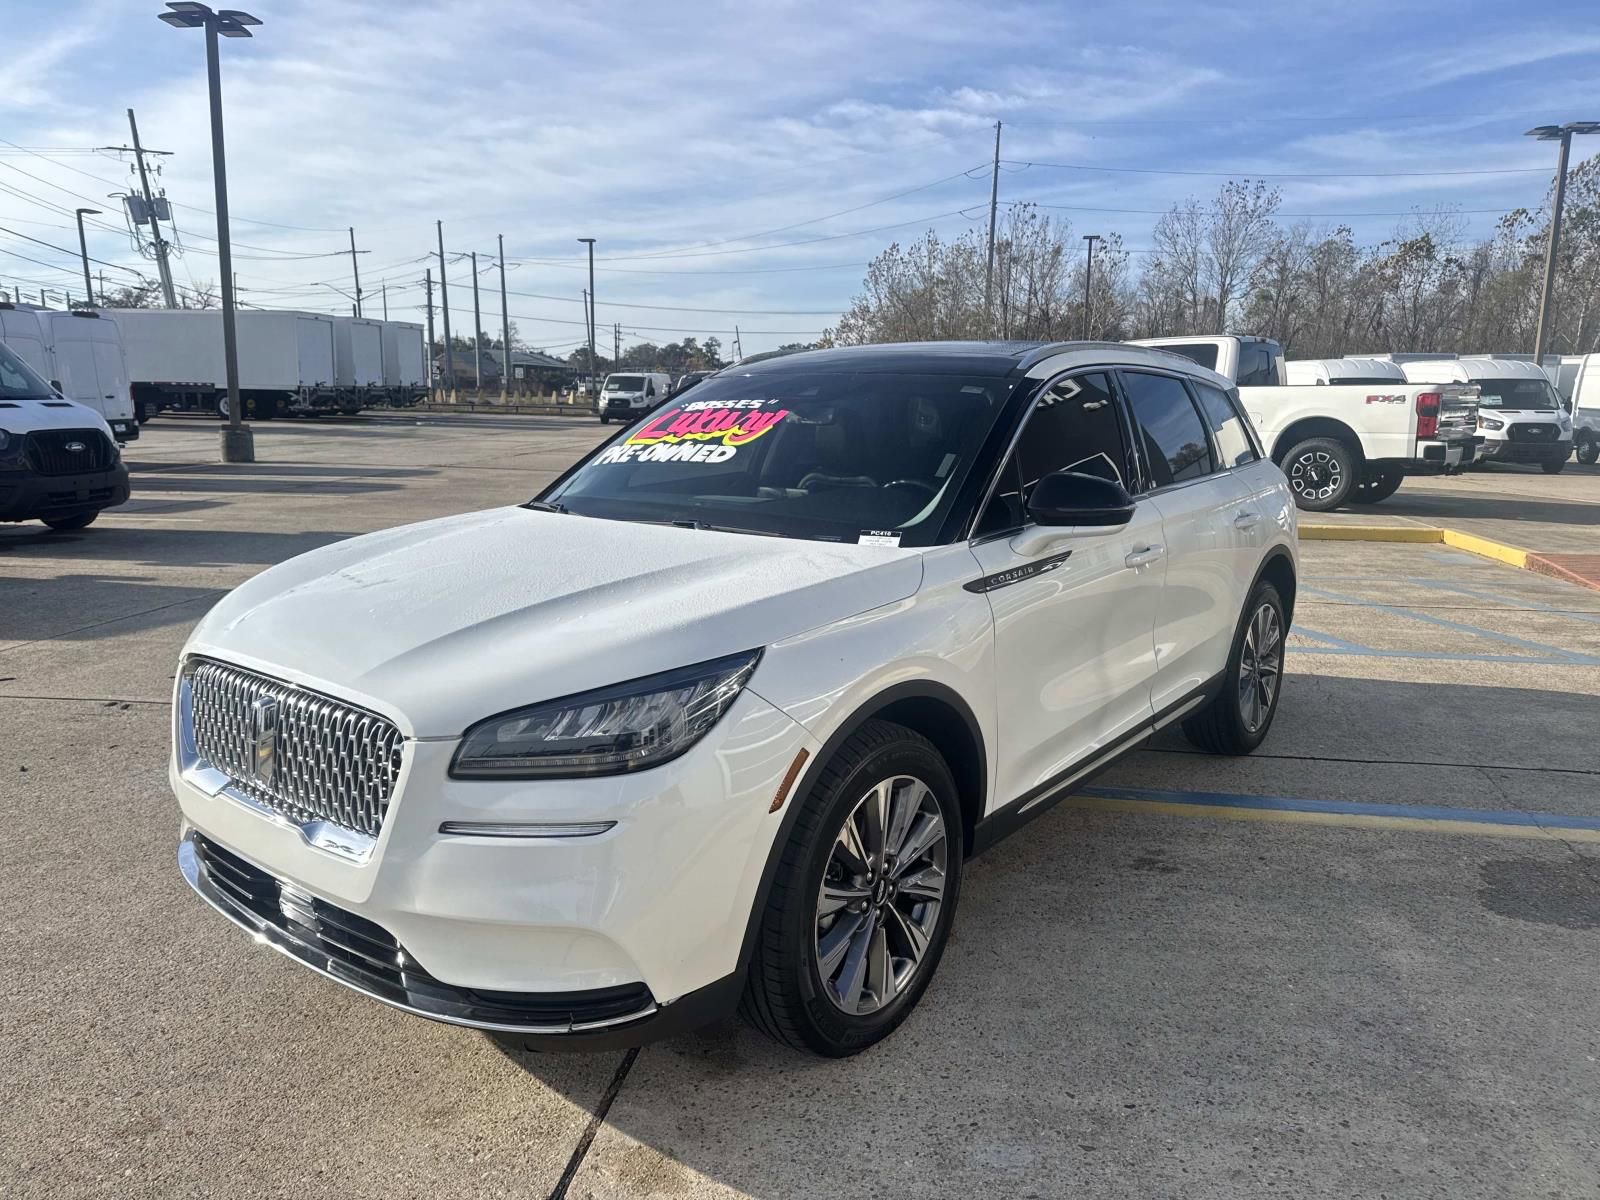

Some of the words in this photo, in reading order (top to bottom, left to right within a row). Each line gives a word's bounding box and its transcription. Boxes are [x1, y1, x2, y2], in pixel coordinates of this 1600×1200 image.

[1366, 395, 1406, 405] FX4
[592, 442, 737, 466] PRE-OWNED
[991, 566, 1034, 585] CORSAIR
